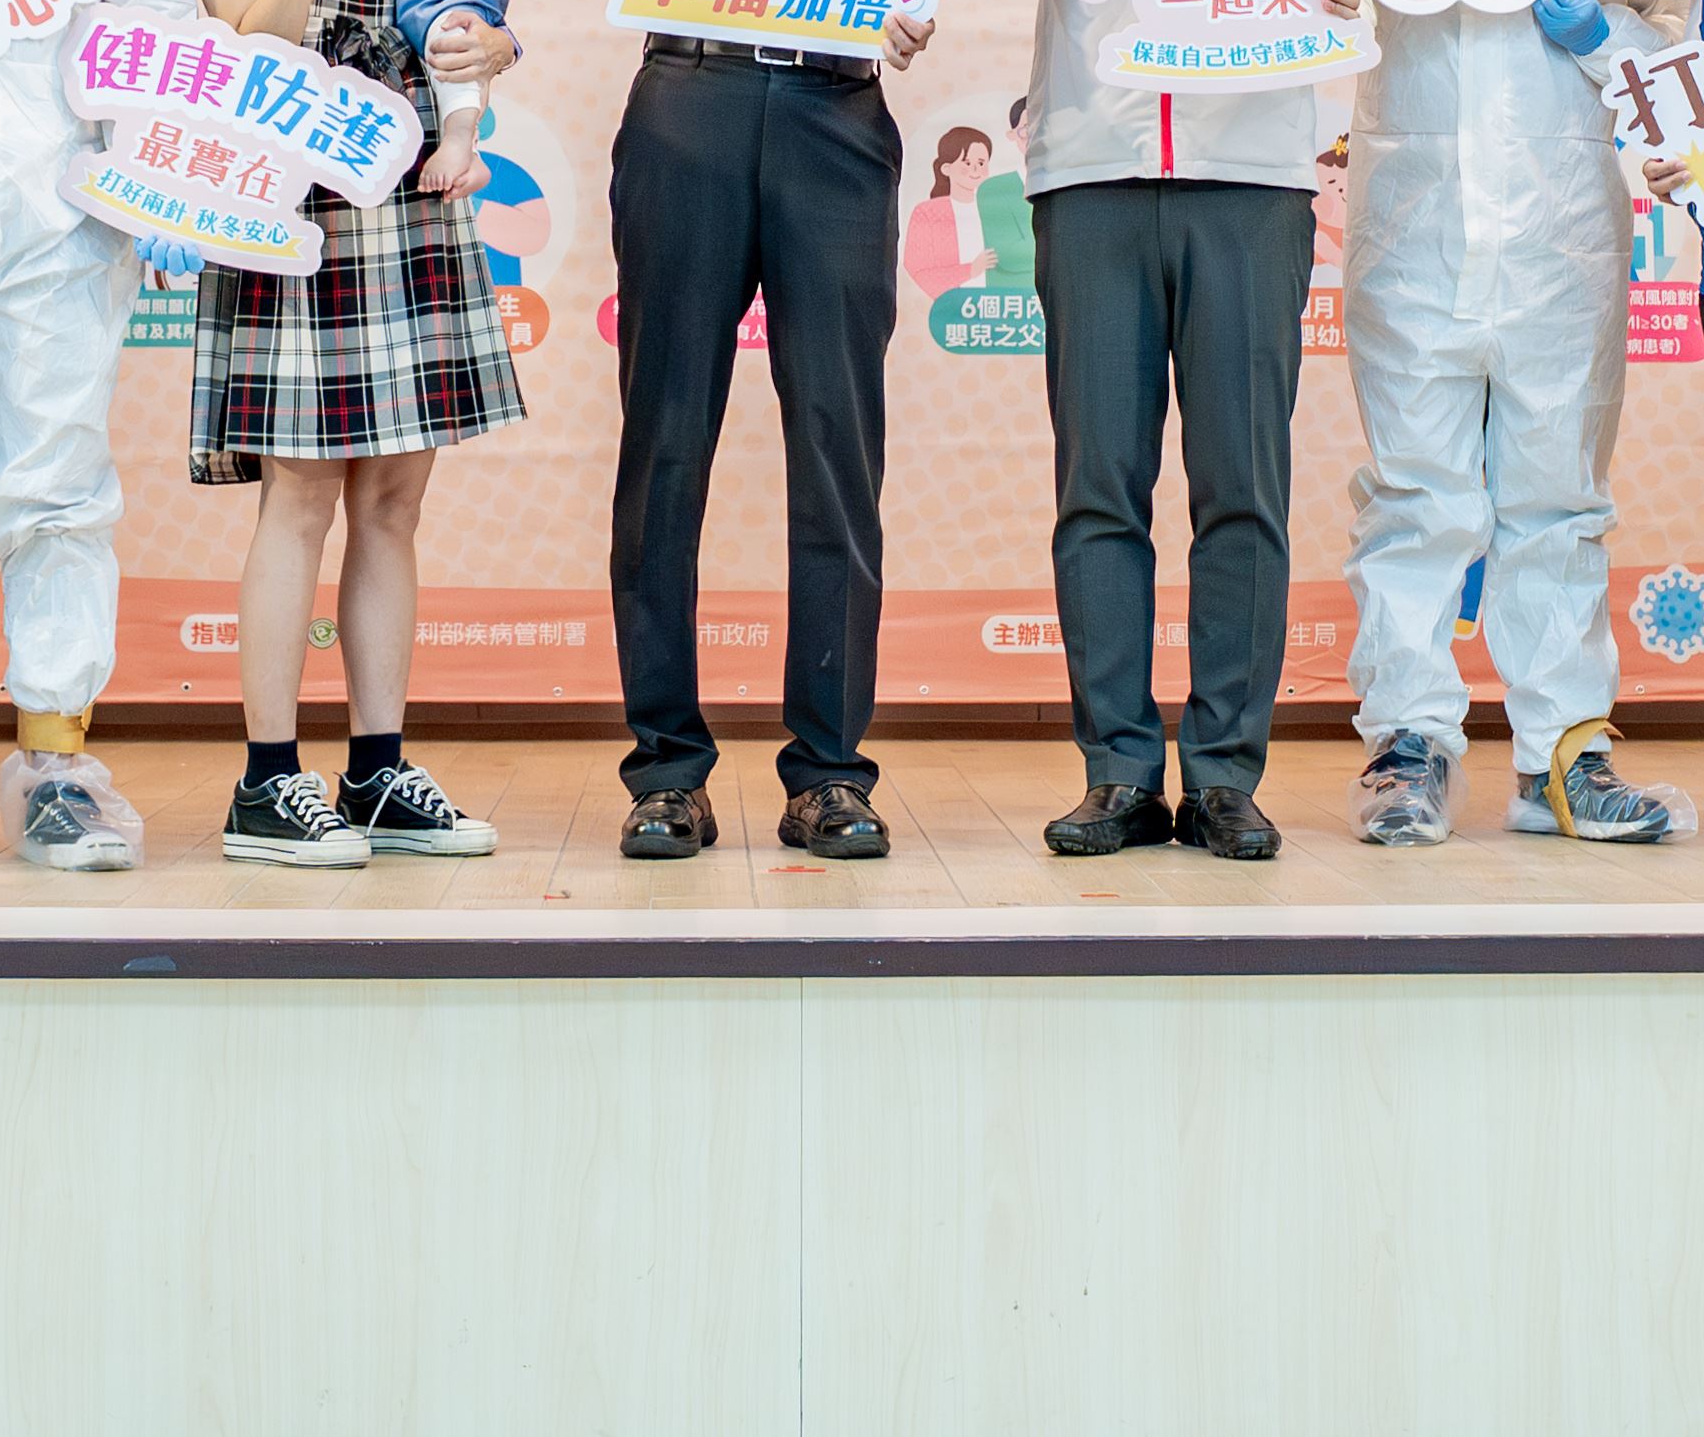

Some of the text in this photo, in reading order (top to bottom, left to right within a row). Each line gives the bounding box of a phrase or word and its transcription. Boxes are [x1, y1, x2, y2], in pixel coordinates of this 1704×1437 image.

[1132, 28, 1346, 68] 保護自己也守護家人
[78, 23, 397, 179] 健康防護
[133, 120, 282, 204] 最實在
[96, 167, 290, 245] 打好兩針 秋冬安心
[945, 323, 1046, 348] 嬰兒之父
[697, 622, 770, 647] 市政府
